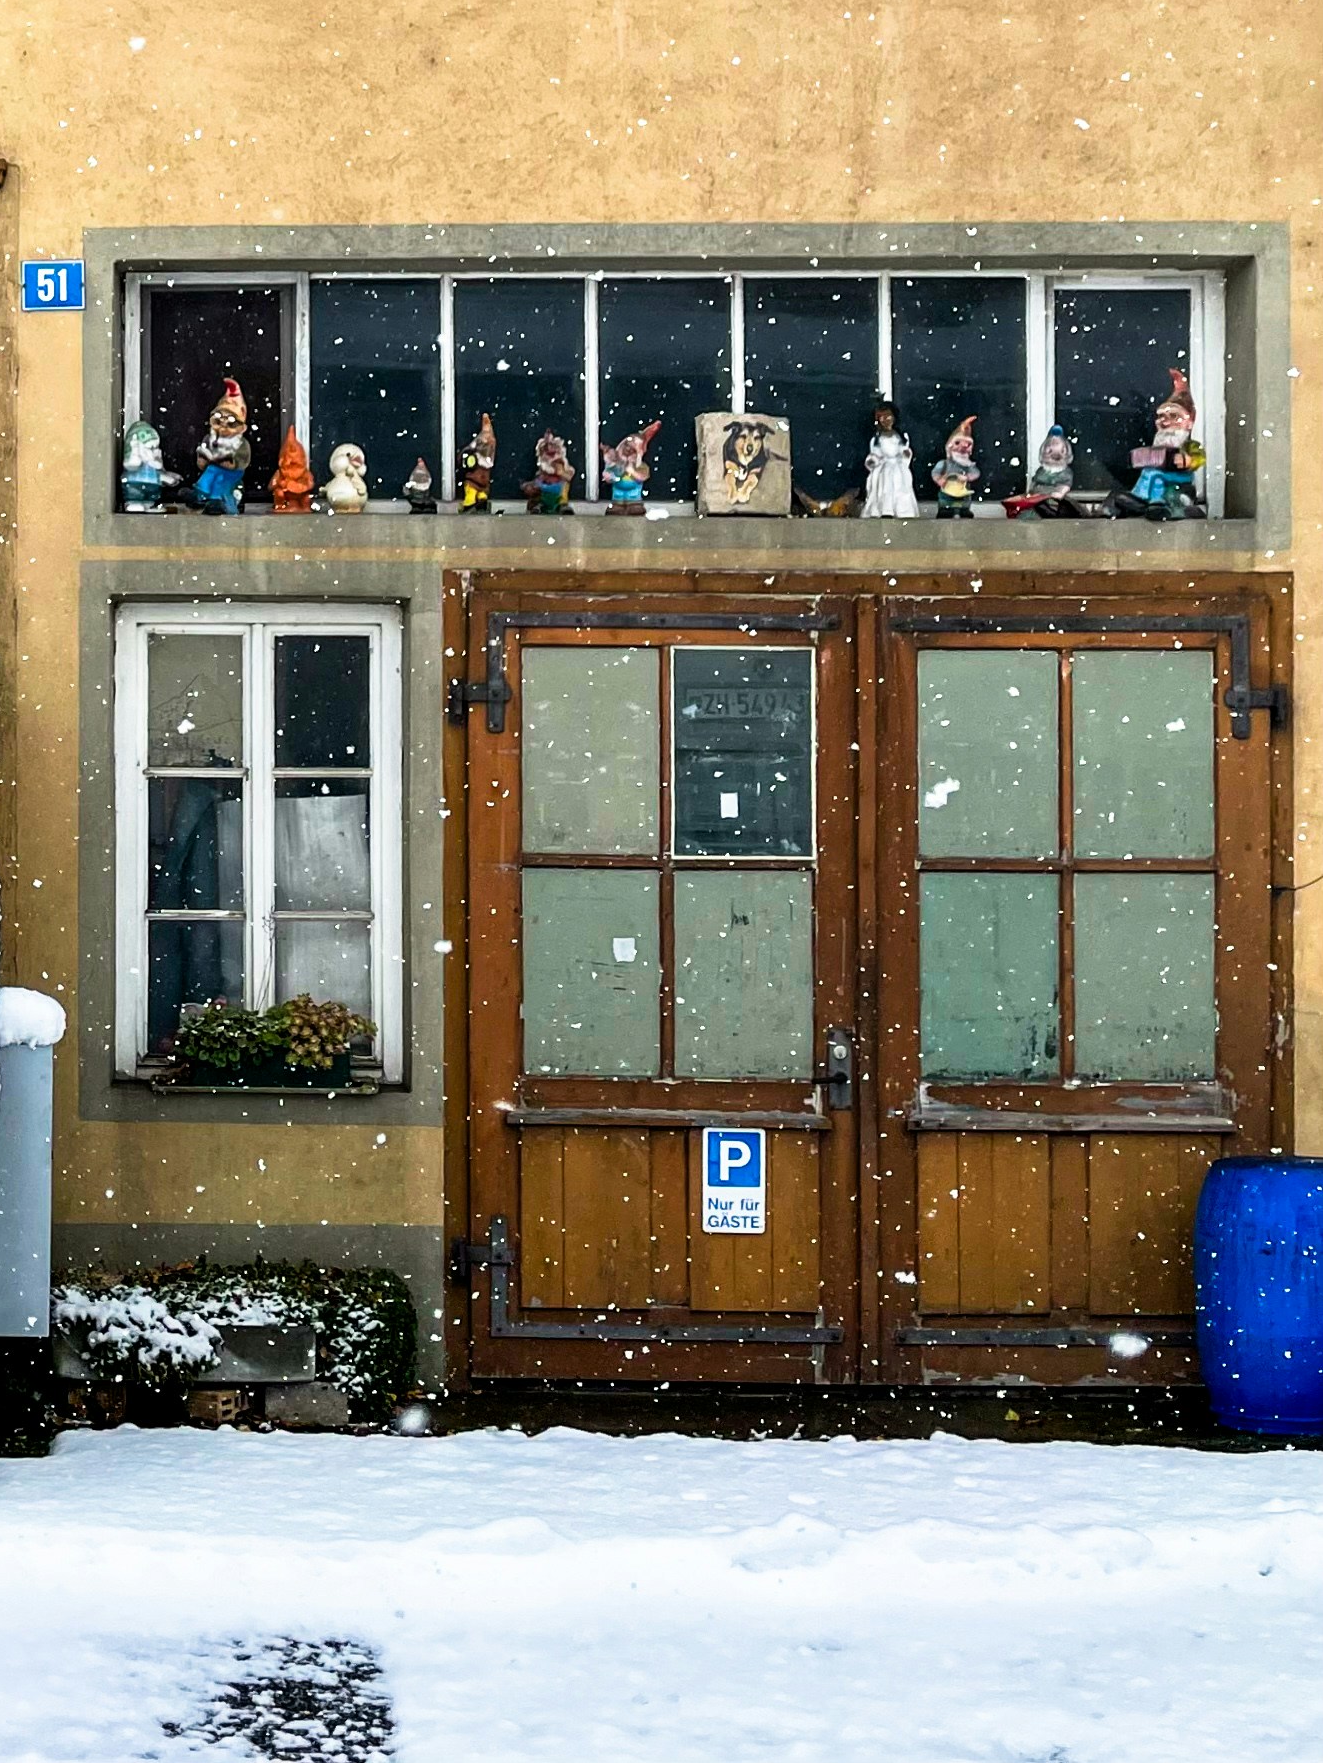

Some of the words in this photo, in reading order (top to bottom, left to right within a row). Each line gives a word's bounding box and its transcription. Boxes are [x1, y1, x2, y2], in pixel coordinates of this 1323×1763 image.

[37, 268, 68, 302] 51
[719, 1140, 752, 1181] P
[707, 1197, 734, 1211] Nur
[740, 1197, 760, 1211] für
[707, 1211, 761, 1229] GÄSTE
